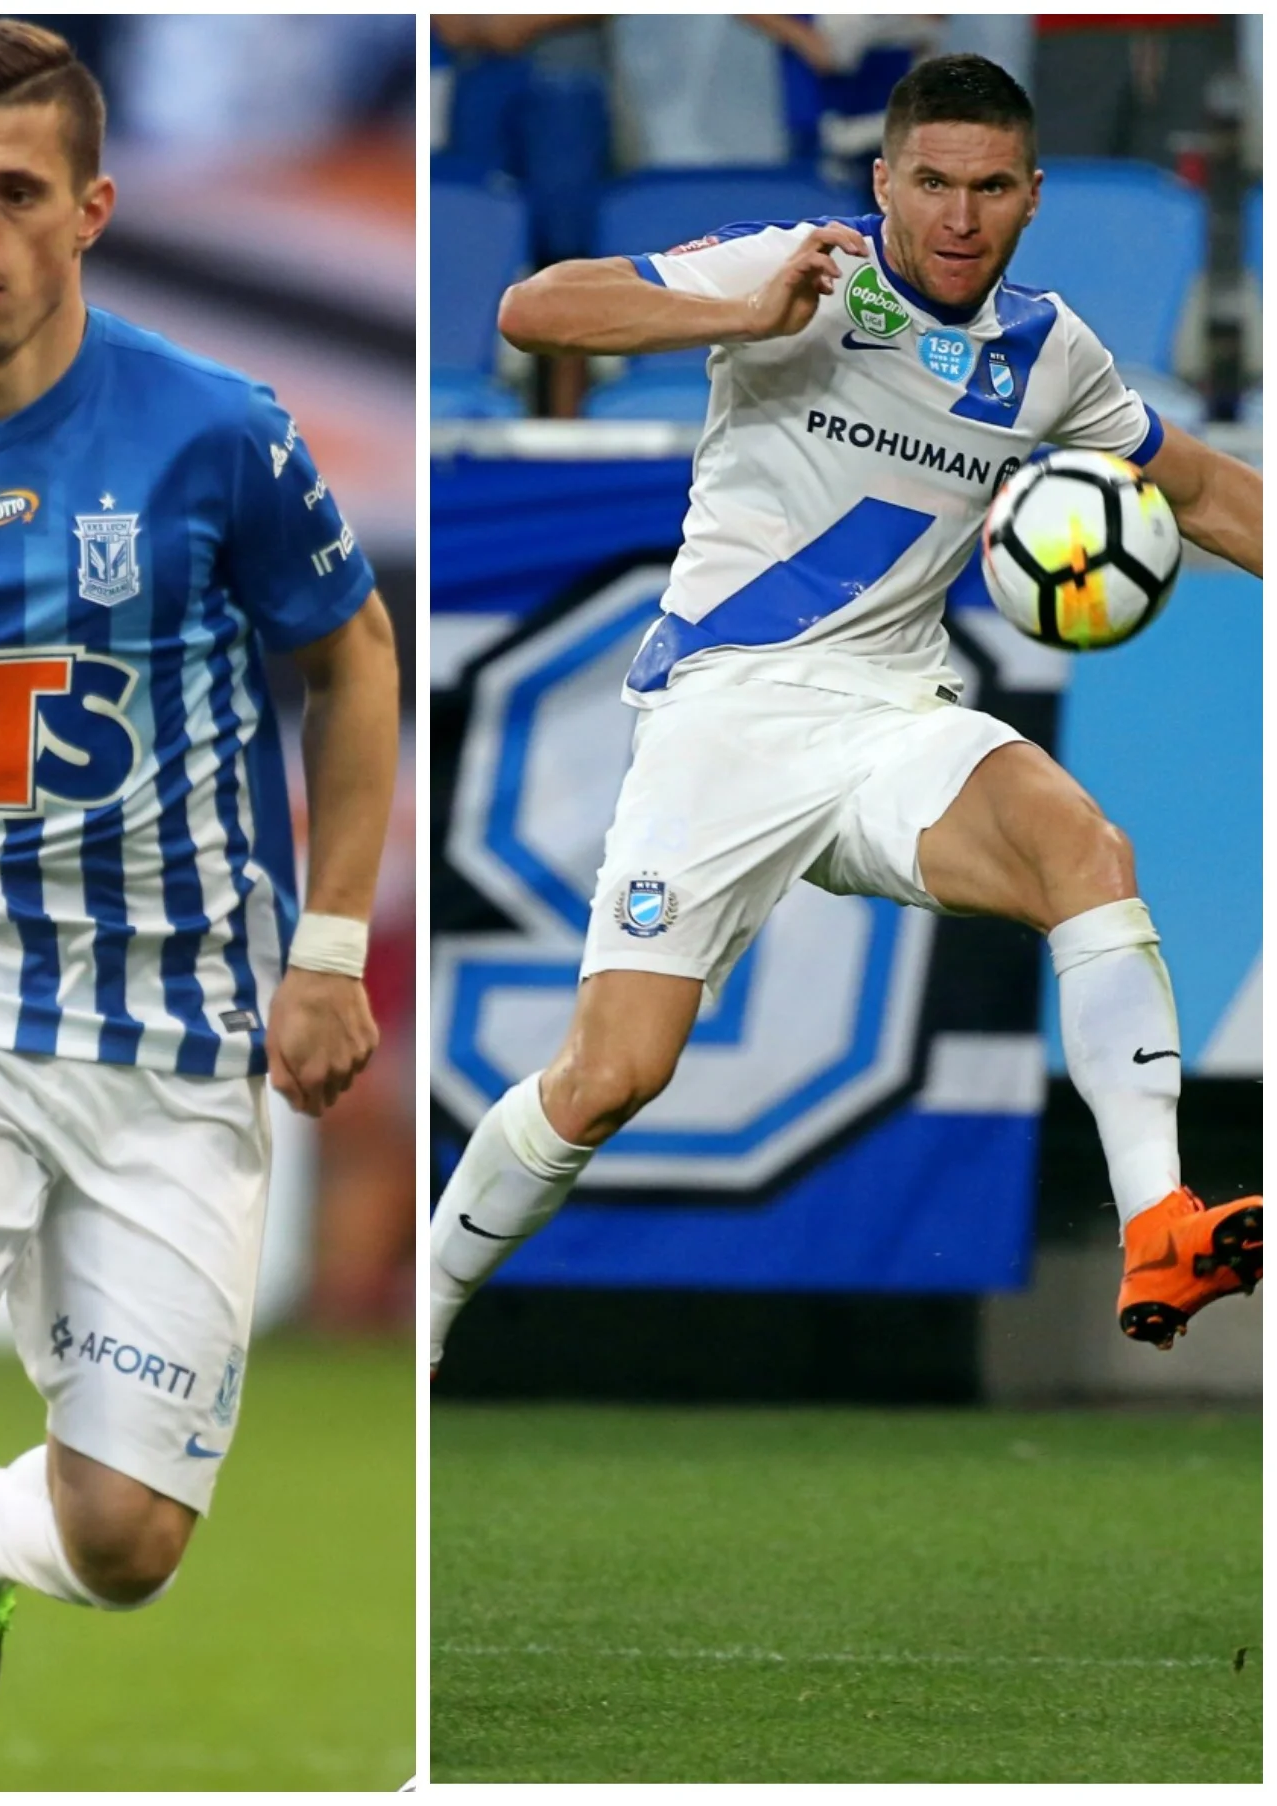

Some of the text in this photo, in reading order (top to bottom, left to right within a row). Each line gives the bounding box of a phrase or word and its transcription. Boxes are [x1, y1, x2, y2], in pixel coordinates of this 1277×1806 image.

[929, 336, 965, 356] 130
[929, 360, 960, 375] MTK
[806, 409, 991, 485] PROHUMAN
[78, 1331, 197, 1400] AFORTI
